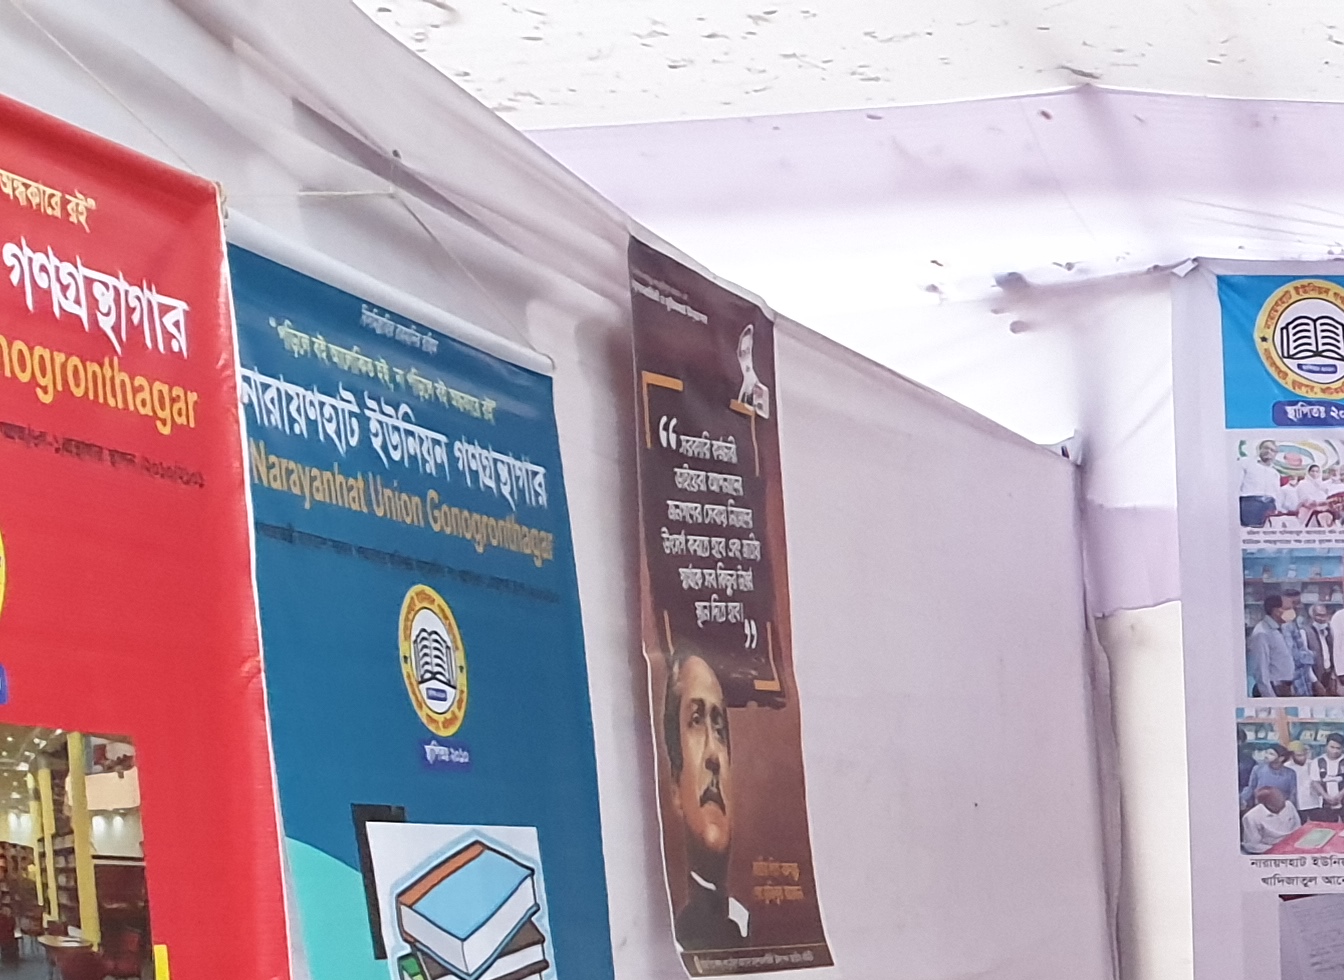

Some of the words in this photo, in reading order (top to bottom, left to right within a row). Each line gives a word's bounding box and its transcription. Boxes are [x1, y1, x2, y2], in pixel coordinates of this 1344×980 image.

[0, 335, 198, 434] nogronthagar
[249, 437, 368, 511] Narayanhat
[368, 470, 424, 527] Union
[426, 488, 553, 568] Gonogronthagar
